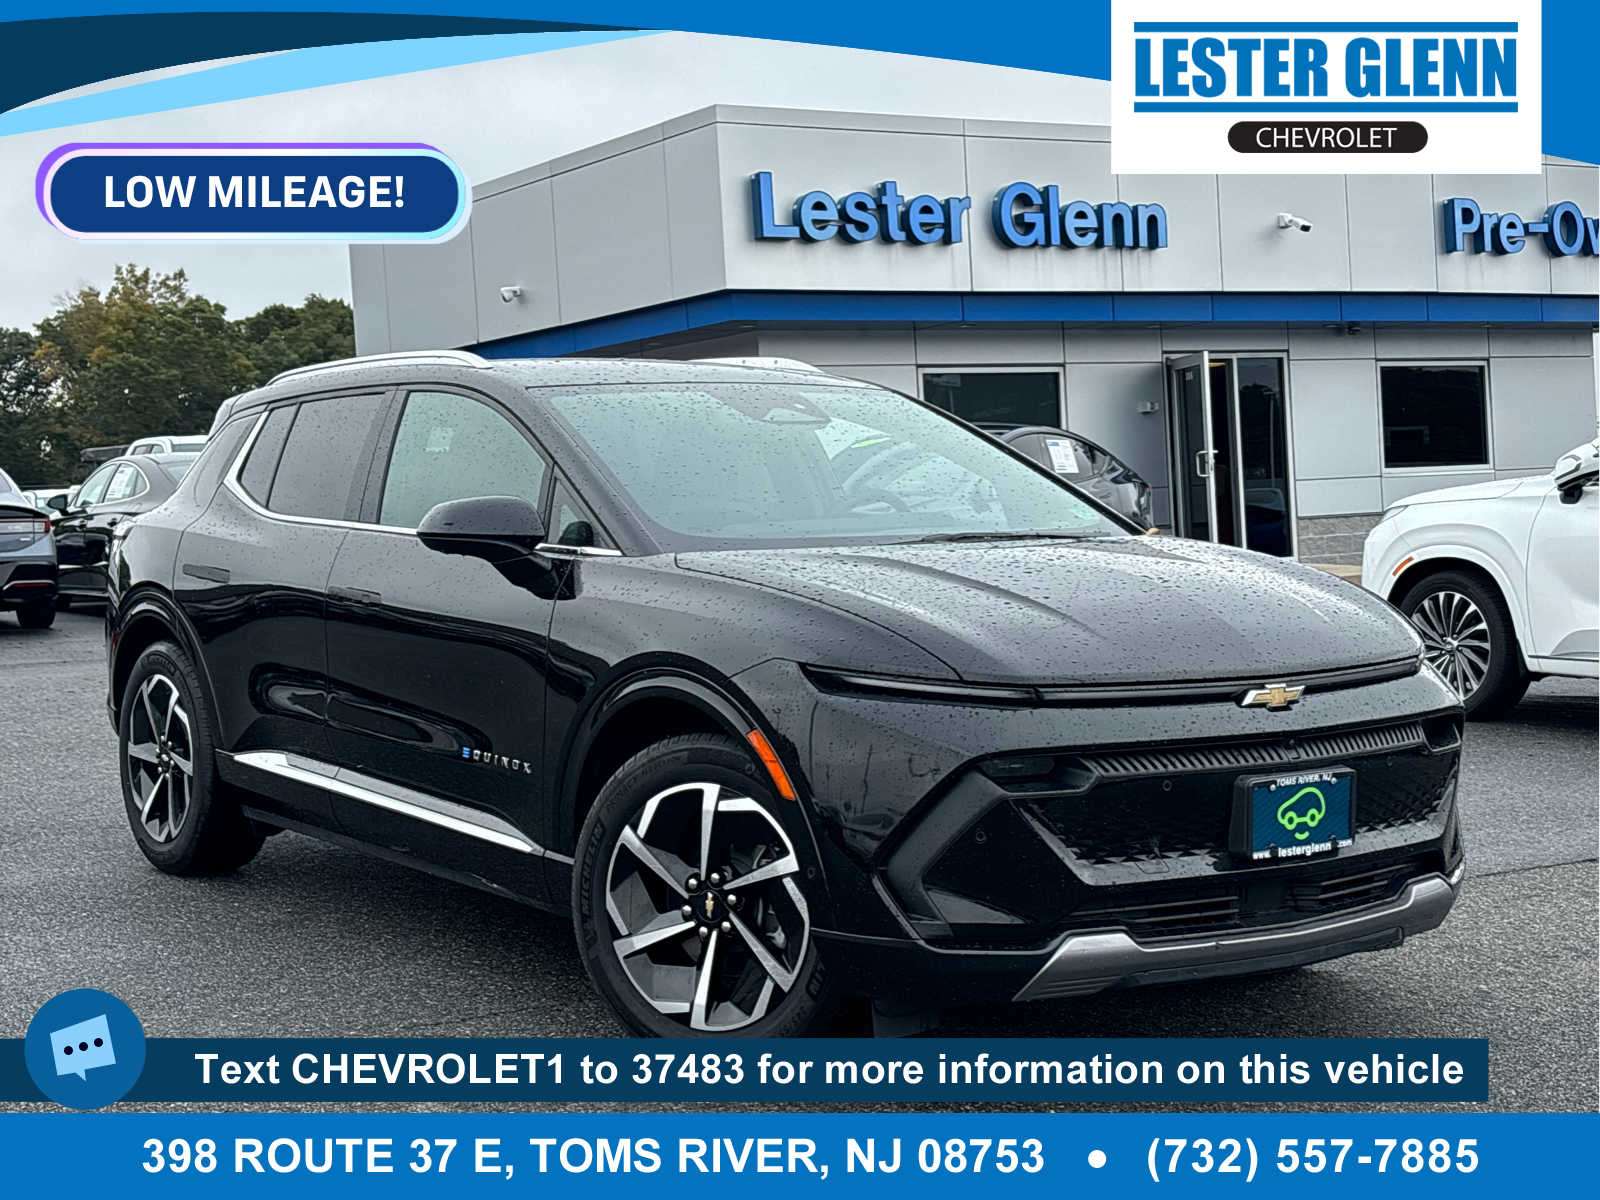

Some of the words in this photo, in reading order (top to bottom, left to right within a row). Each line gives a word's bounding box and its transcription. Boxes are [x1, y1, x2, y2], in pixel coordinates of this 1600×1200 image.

[752, 171, 971, 244] Lester
[993, 181, 1168, 249] Glenn
[462, 746, 532, 774] EQUINOX
[1276, 776, 1297, 787] TOMS
